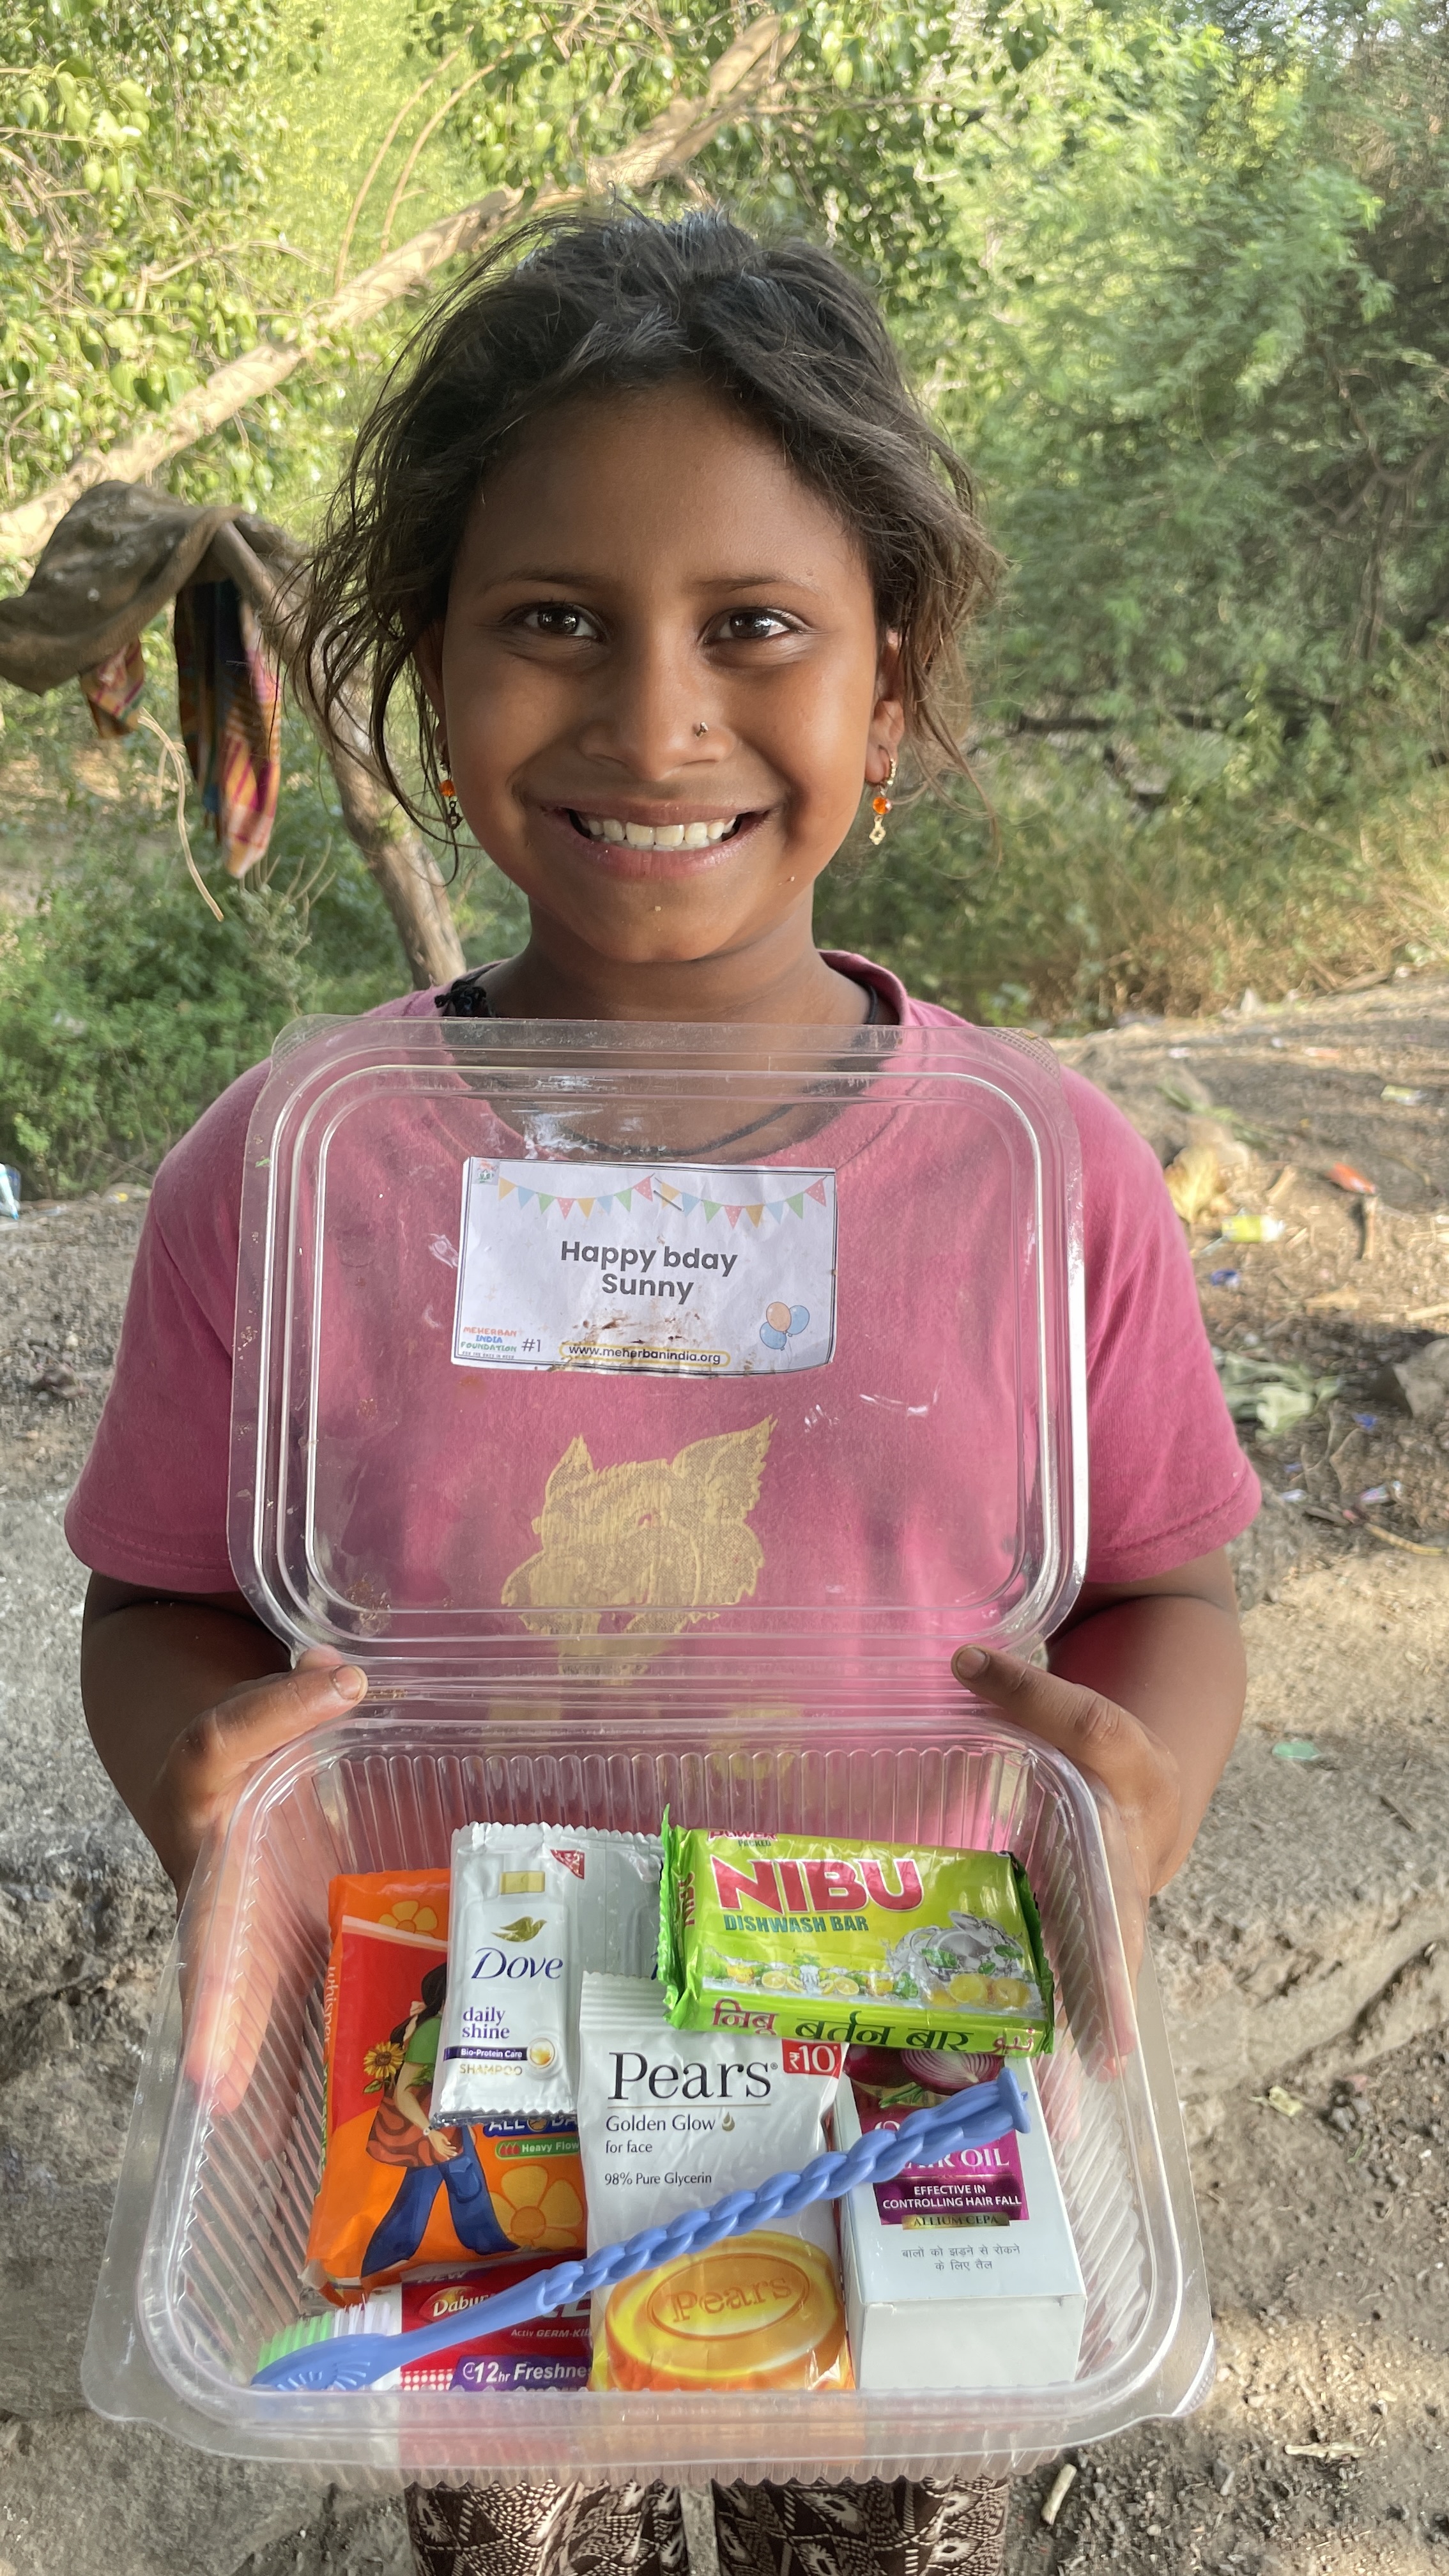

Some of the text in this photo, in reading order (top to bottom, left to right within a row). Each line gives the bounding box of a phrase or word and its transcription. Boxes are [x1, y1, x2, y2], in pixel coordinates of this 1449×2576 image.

[561, 1241, 738, 1276] Happy bday
[602, 1273, 694, 1305] Sunny
[463, 1326, 517, 1337] MEHERBAN
[475, 1335, 503, 1343] INDIA
[460, 1342, 518, 1352] FOUNDATION
[521, 1338, 540, 1352] #1
[569, 1346, 721, 1365] www.meherbanindia.org
[709, 1854, 924, 1915] NIBU
[723, 1915, 869, 1933] DISHWASH BAR
[471, 1947, 564, 1979] Dove
[463, 2007, 505, 2026] daily
[462, 2023, 510, 2039] shine
[906, 2027, 975, 2051] बार
[461, 2048, 523, 2058] Bio-Protein Care
[459, 2064, 523, 2076] SHAMPOO
[606, 2113, 716, 2131] Golden Glow
[522, 2141, 579, 2152] Heavy Flow
[606, 2140, 653, 2154] for face
[960, 2148, 1009, 2167] OIL
[604, 2171, 712, 2186] 98% Pure Glycerin
[914, 2184, 986, 2196] EFFECTIVE IN
[883, 2195, 1022, 2209] CONTROLLING HAIR FALL
[914, 2215, 999, 2226] ALLIUM CEPA
[901, 2246, 924, 2258] बालों
[930, 2245, 943, 2257] को
[978, 2244, 988, 2255] से
[993, 2243, 1020, 2255] रोकने
[934, 2260, 944, 2271] के
[951, 2258, 970, 2271] लिए
[671, 2274, 793, 2323] Pears
[511, 2329, 535, 2337] Activ
